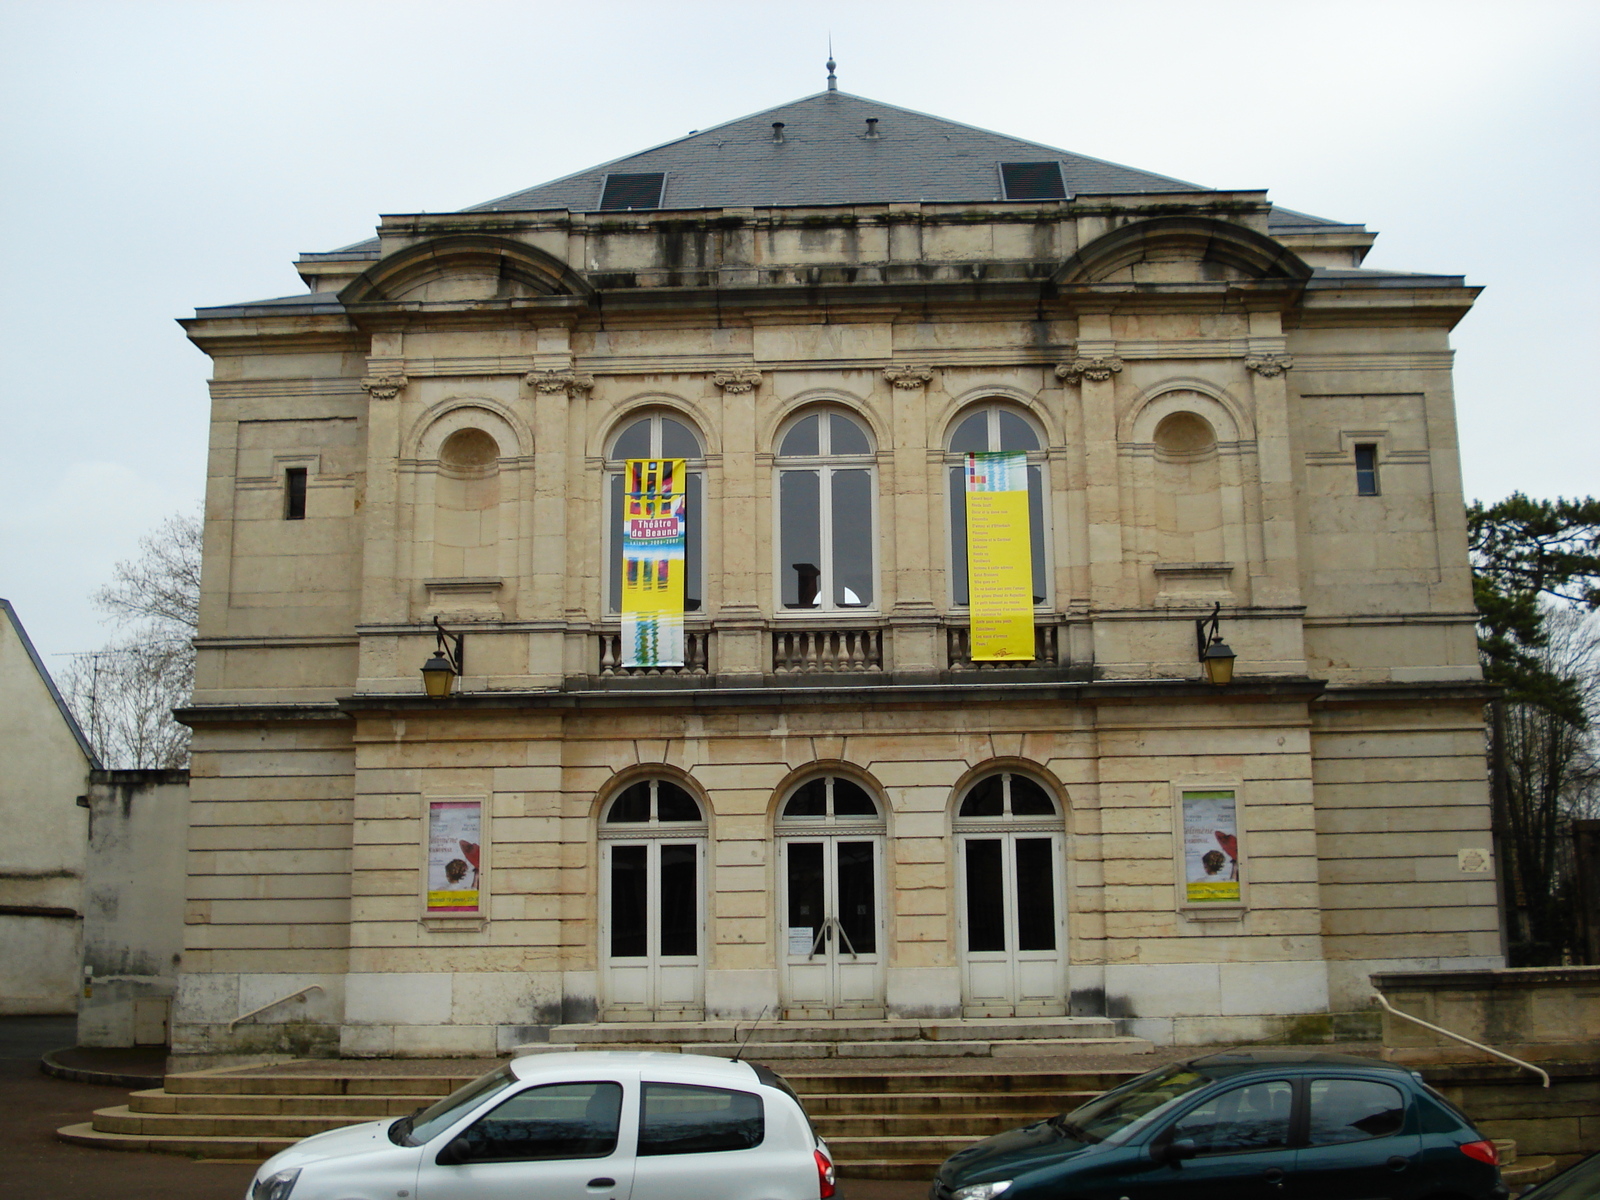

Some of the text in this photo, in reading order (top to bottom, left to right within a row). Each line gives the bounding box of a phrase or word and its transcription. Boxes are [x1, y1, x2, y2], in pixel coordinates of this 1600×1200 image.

[638, 520, 672, 528] Théâtre
[632, 528, 677, 537] de Beaune
